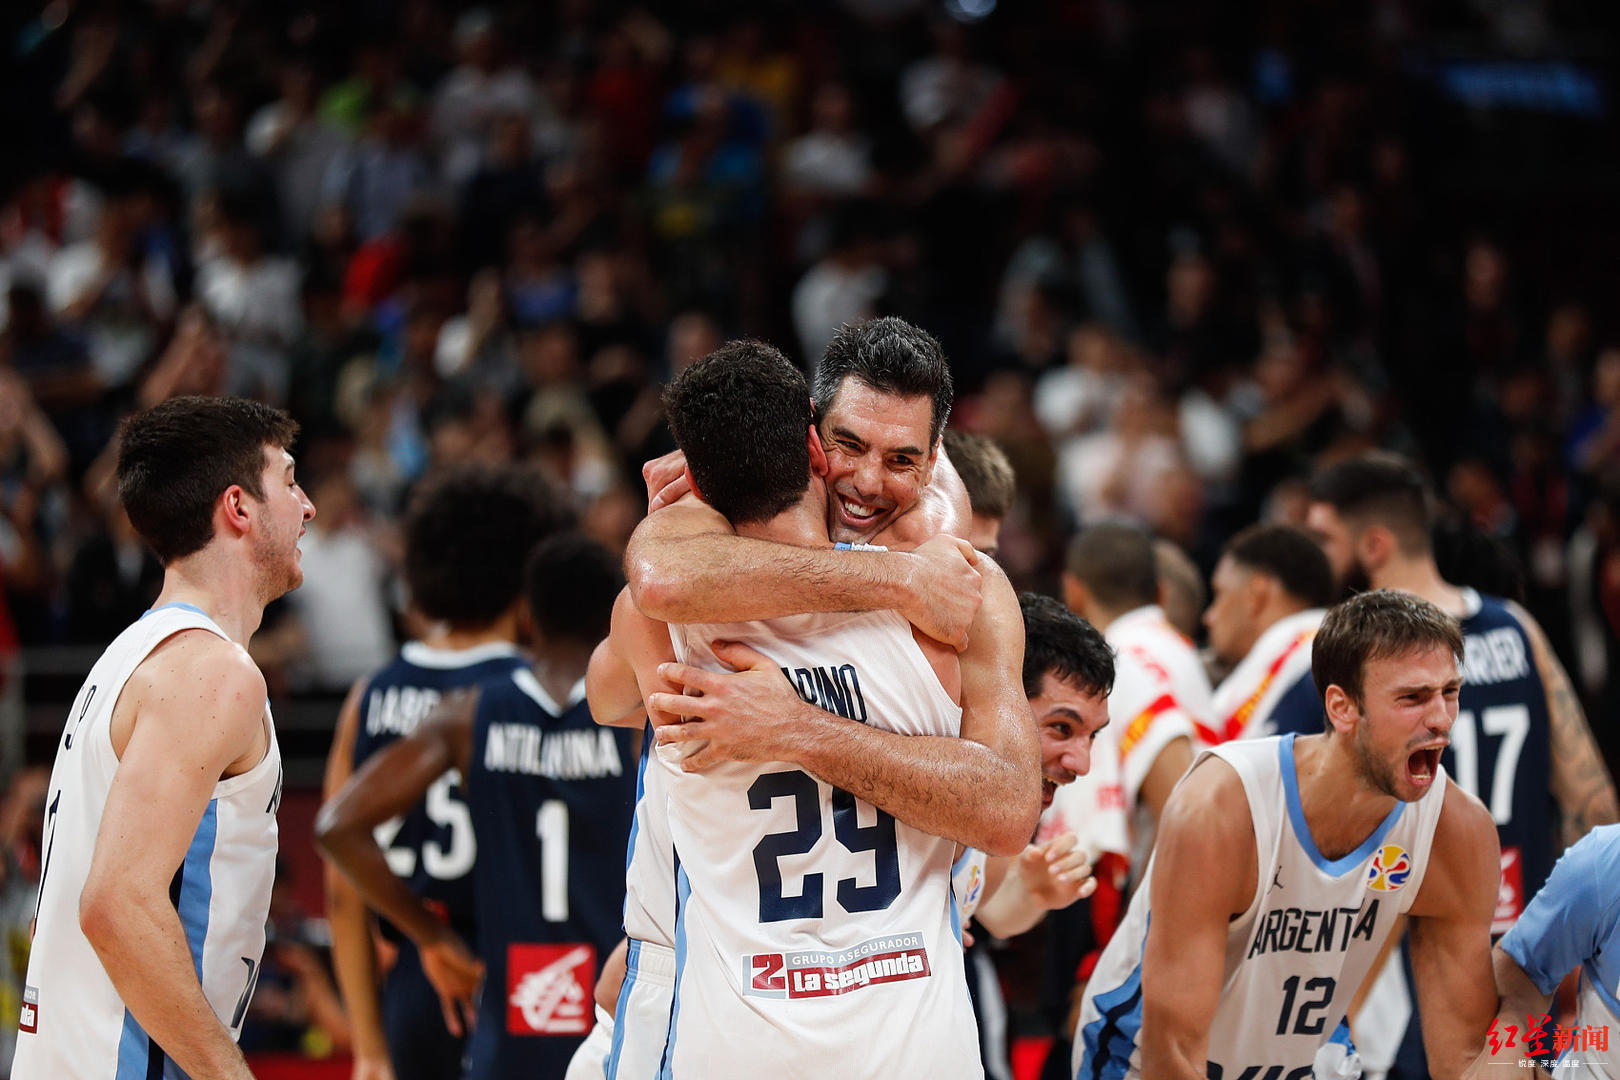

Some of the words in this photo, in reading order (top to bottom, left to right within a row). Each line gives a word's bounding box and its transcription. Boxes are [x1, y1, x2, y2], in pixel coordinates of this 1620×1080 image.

[536, 799, 569, 922] 1
[747, 770, 902, 923] 29
[791, 954, 834, 966] GRUPO
[838, 936, 919, 964] ASEGURADOR
[824, 953, 924, 990] segunda
[1276, 975, 1336, 1035] 12
